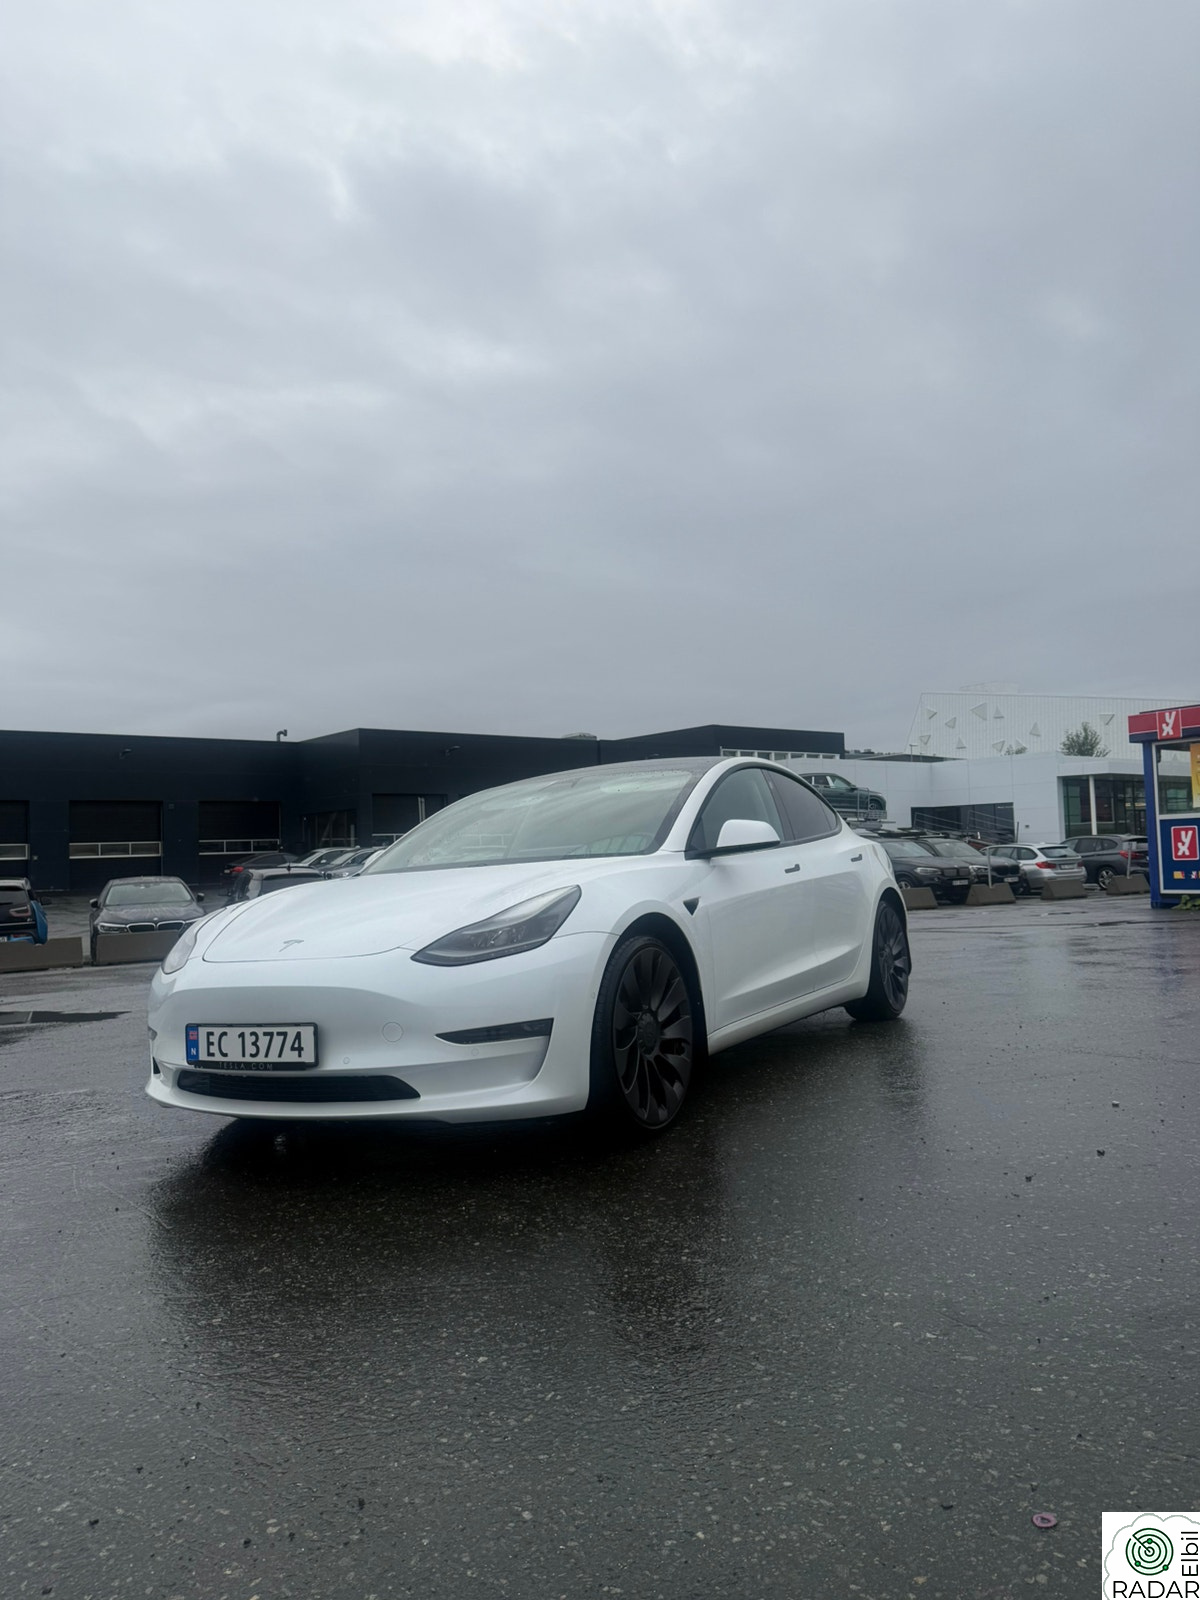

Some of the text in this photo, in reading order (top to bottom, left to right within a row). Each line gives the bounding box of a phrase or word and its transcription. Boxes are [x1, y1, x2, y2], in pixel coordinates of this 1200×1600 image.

[191, 1047, 197, 1056] N
[206, 1030, 304, 1058] EC 13774
